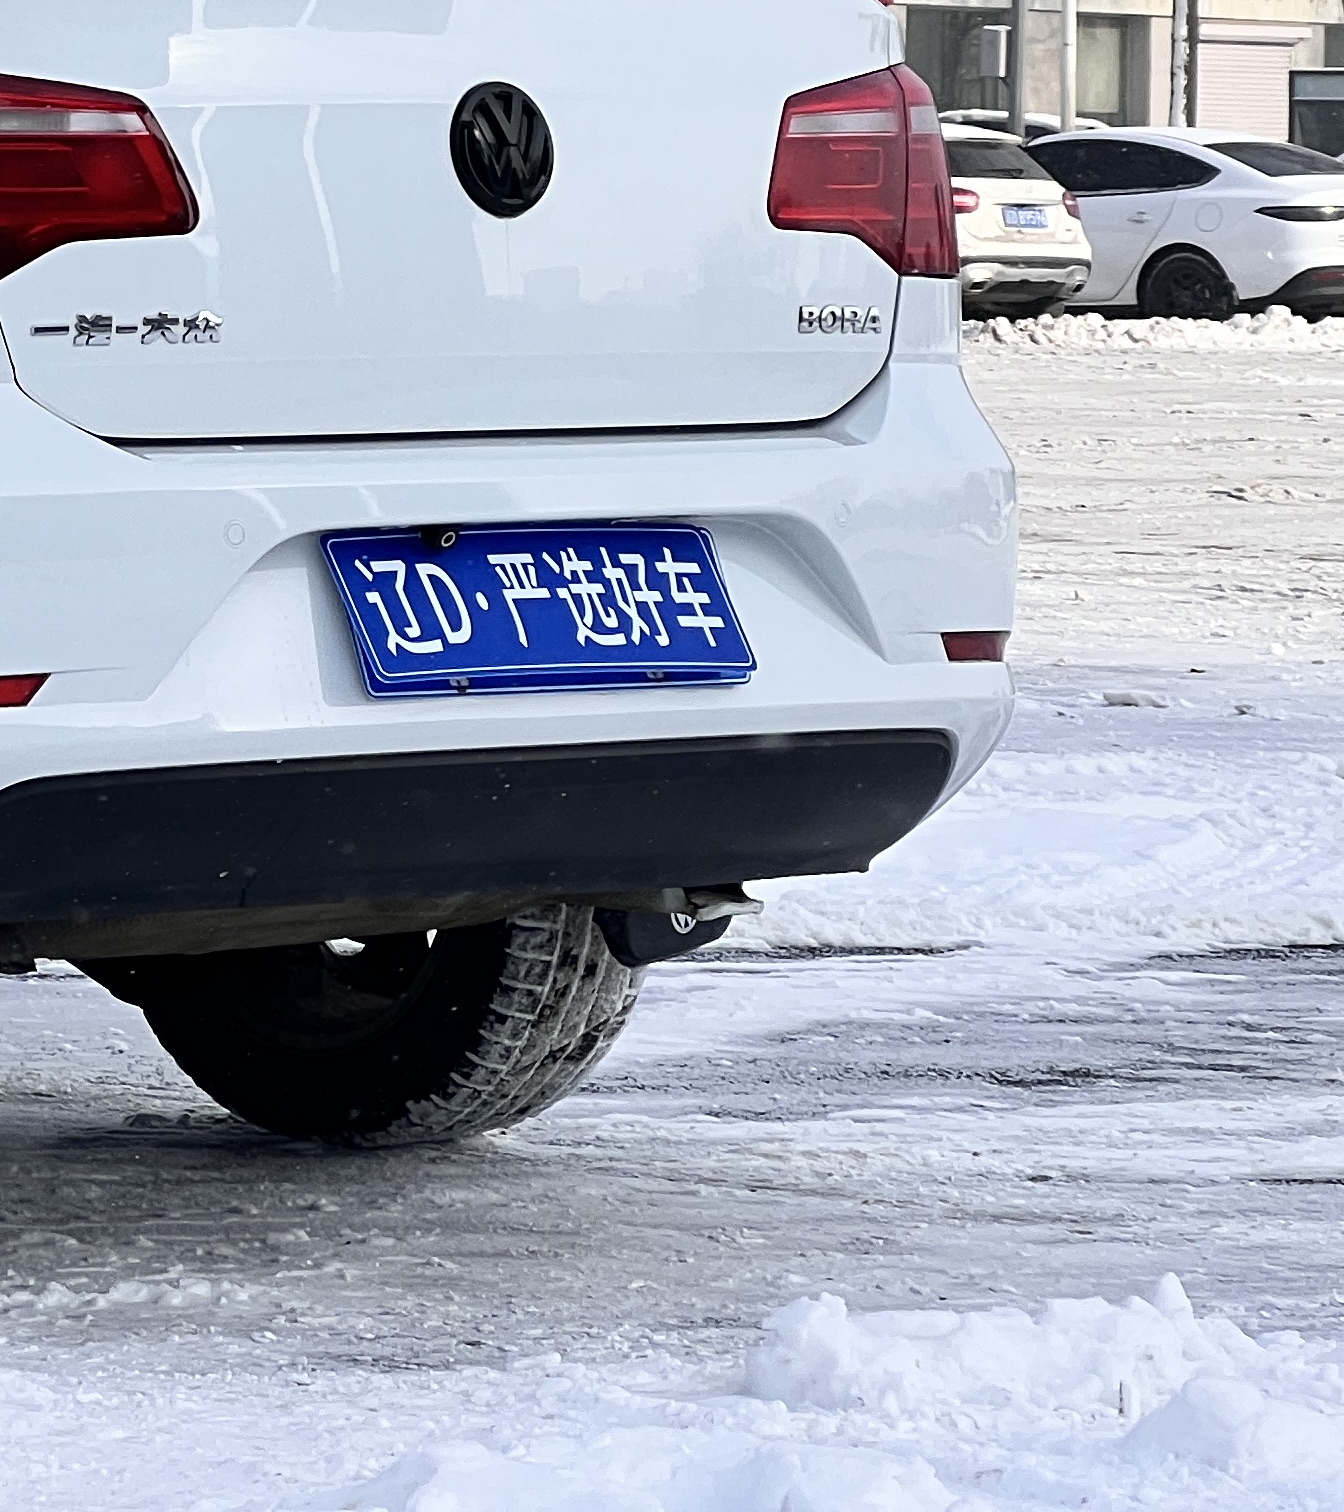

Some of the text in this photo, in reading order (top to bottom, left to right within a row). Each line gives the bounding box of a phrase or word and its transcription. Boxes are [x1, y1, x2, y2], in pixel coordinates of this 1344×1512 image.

[30, 310, 223, 346] 一汽-大众
[798, 304, 881, 334] BORA
[354, 546, 726, 657] 辽D·严选好车
